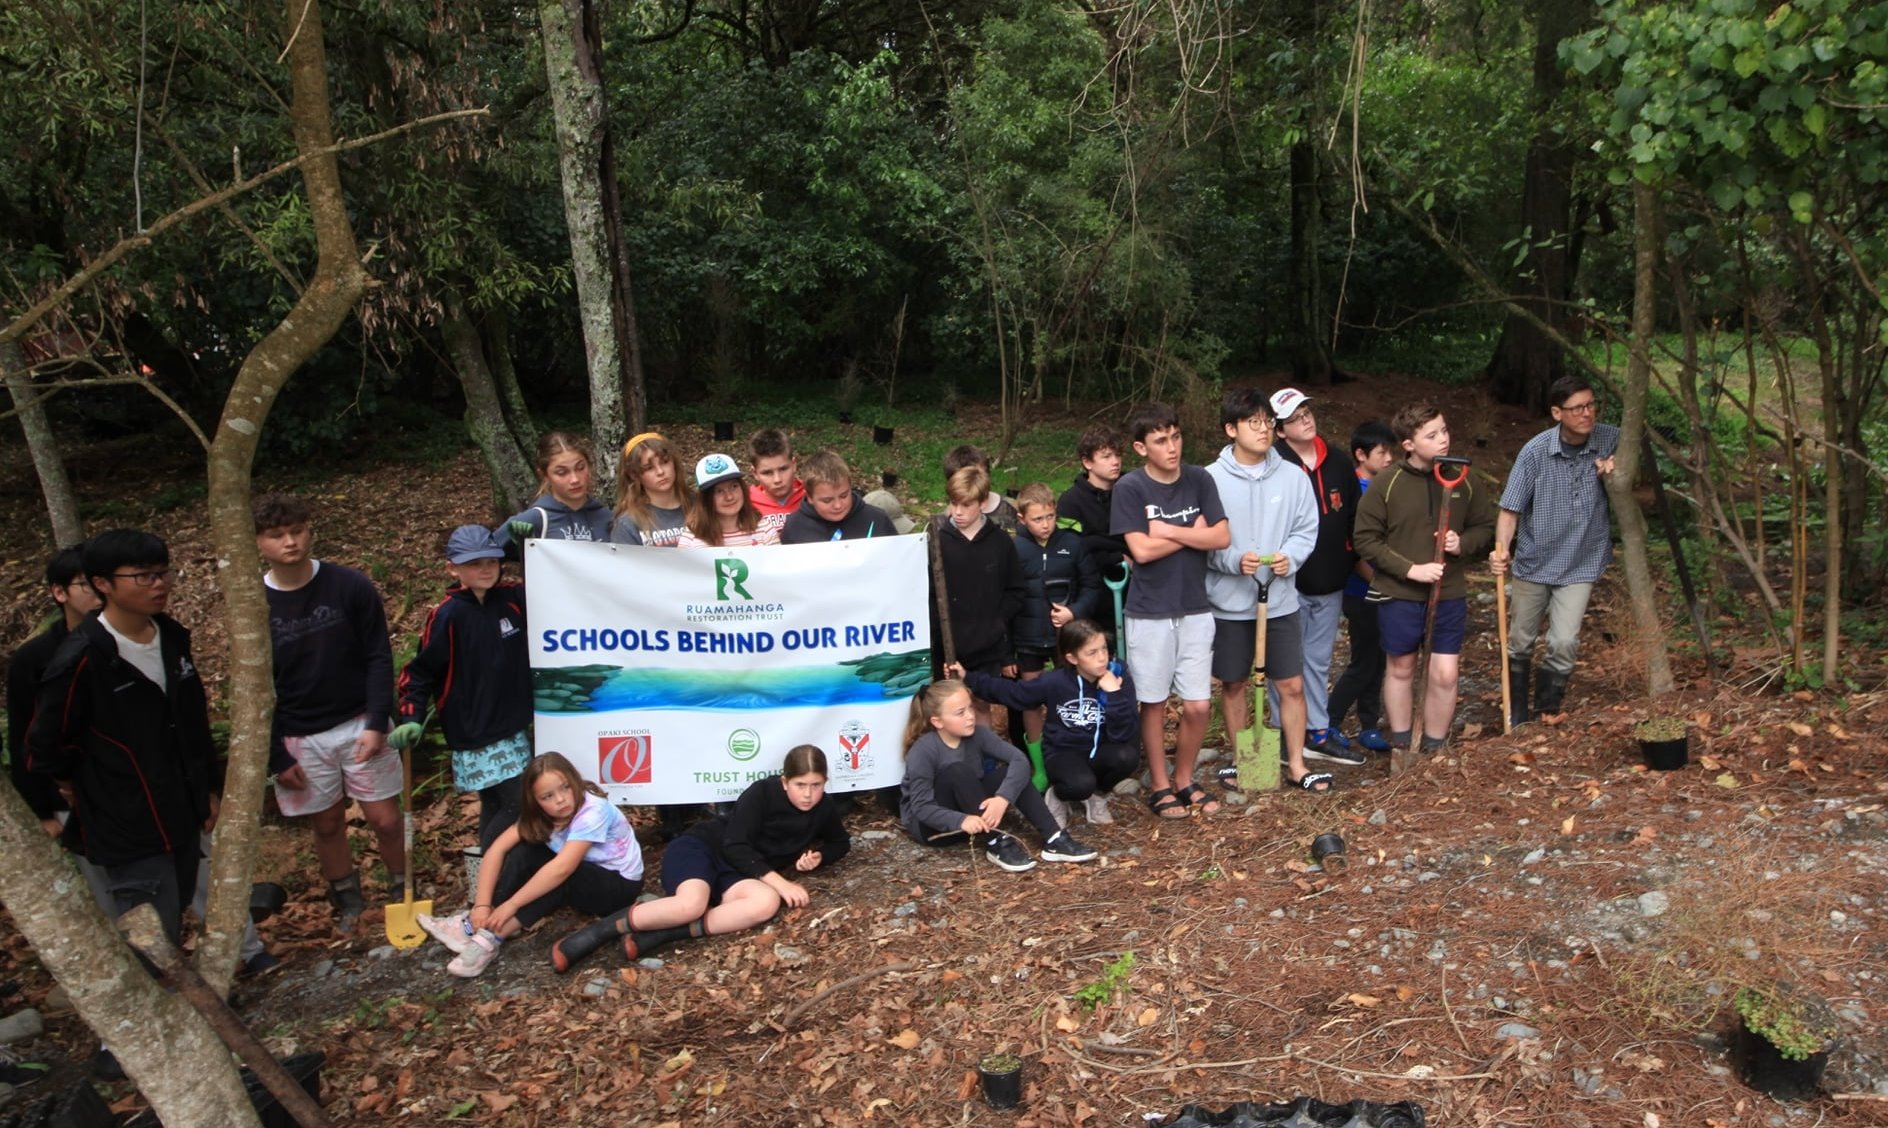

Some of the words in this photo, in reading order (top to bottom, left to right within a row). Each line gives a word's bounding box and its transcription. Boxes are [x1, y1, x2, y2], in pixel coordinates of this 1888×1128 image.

[686, 603, 784, 614] RUAMAHANGA
[687, 614, 752, 622] RESTORATION
[756, 613, 783, 621] TRUST
[543, 629, 670, 653] SCHOOLS
[677, 631, 775, 654] BEHIND
[782, 627, 837, 651] OUR
[845, 621, 916, 647] RIVER
[694, 771, 740, 783] TRUST
